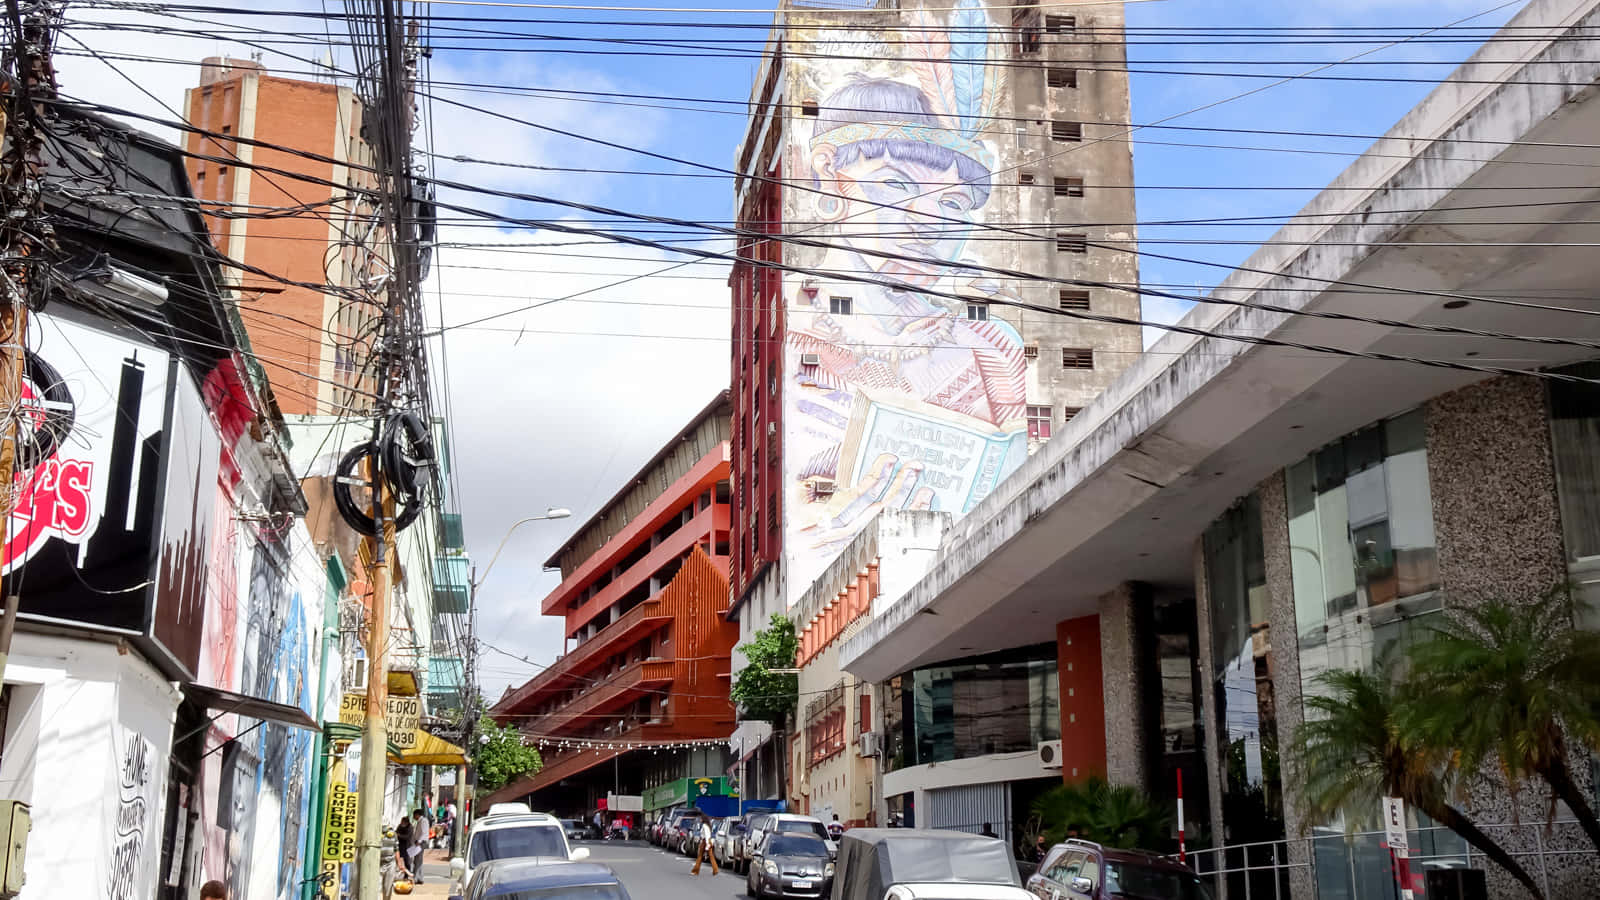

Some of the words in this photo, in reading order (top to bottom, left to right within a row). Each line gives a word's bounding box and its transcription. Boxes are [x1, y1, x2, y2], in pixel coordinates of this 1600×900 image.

[396, 701, 417, 716] ORO
[330, 784, 346, 828] COMPRO
[343, 795, 357, 834] COMPRO
[327, 831, 341, 856] ORO
[342, 837, 354, 860] ORO
